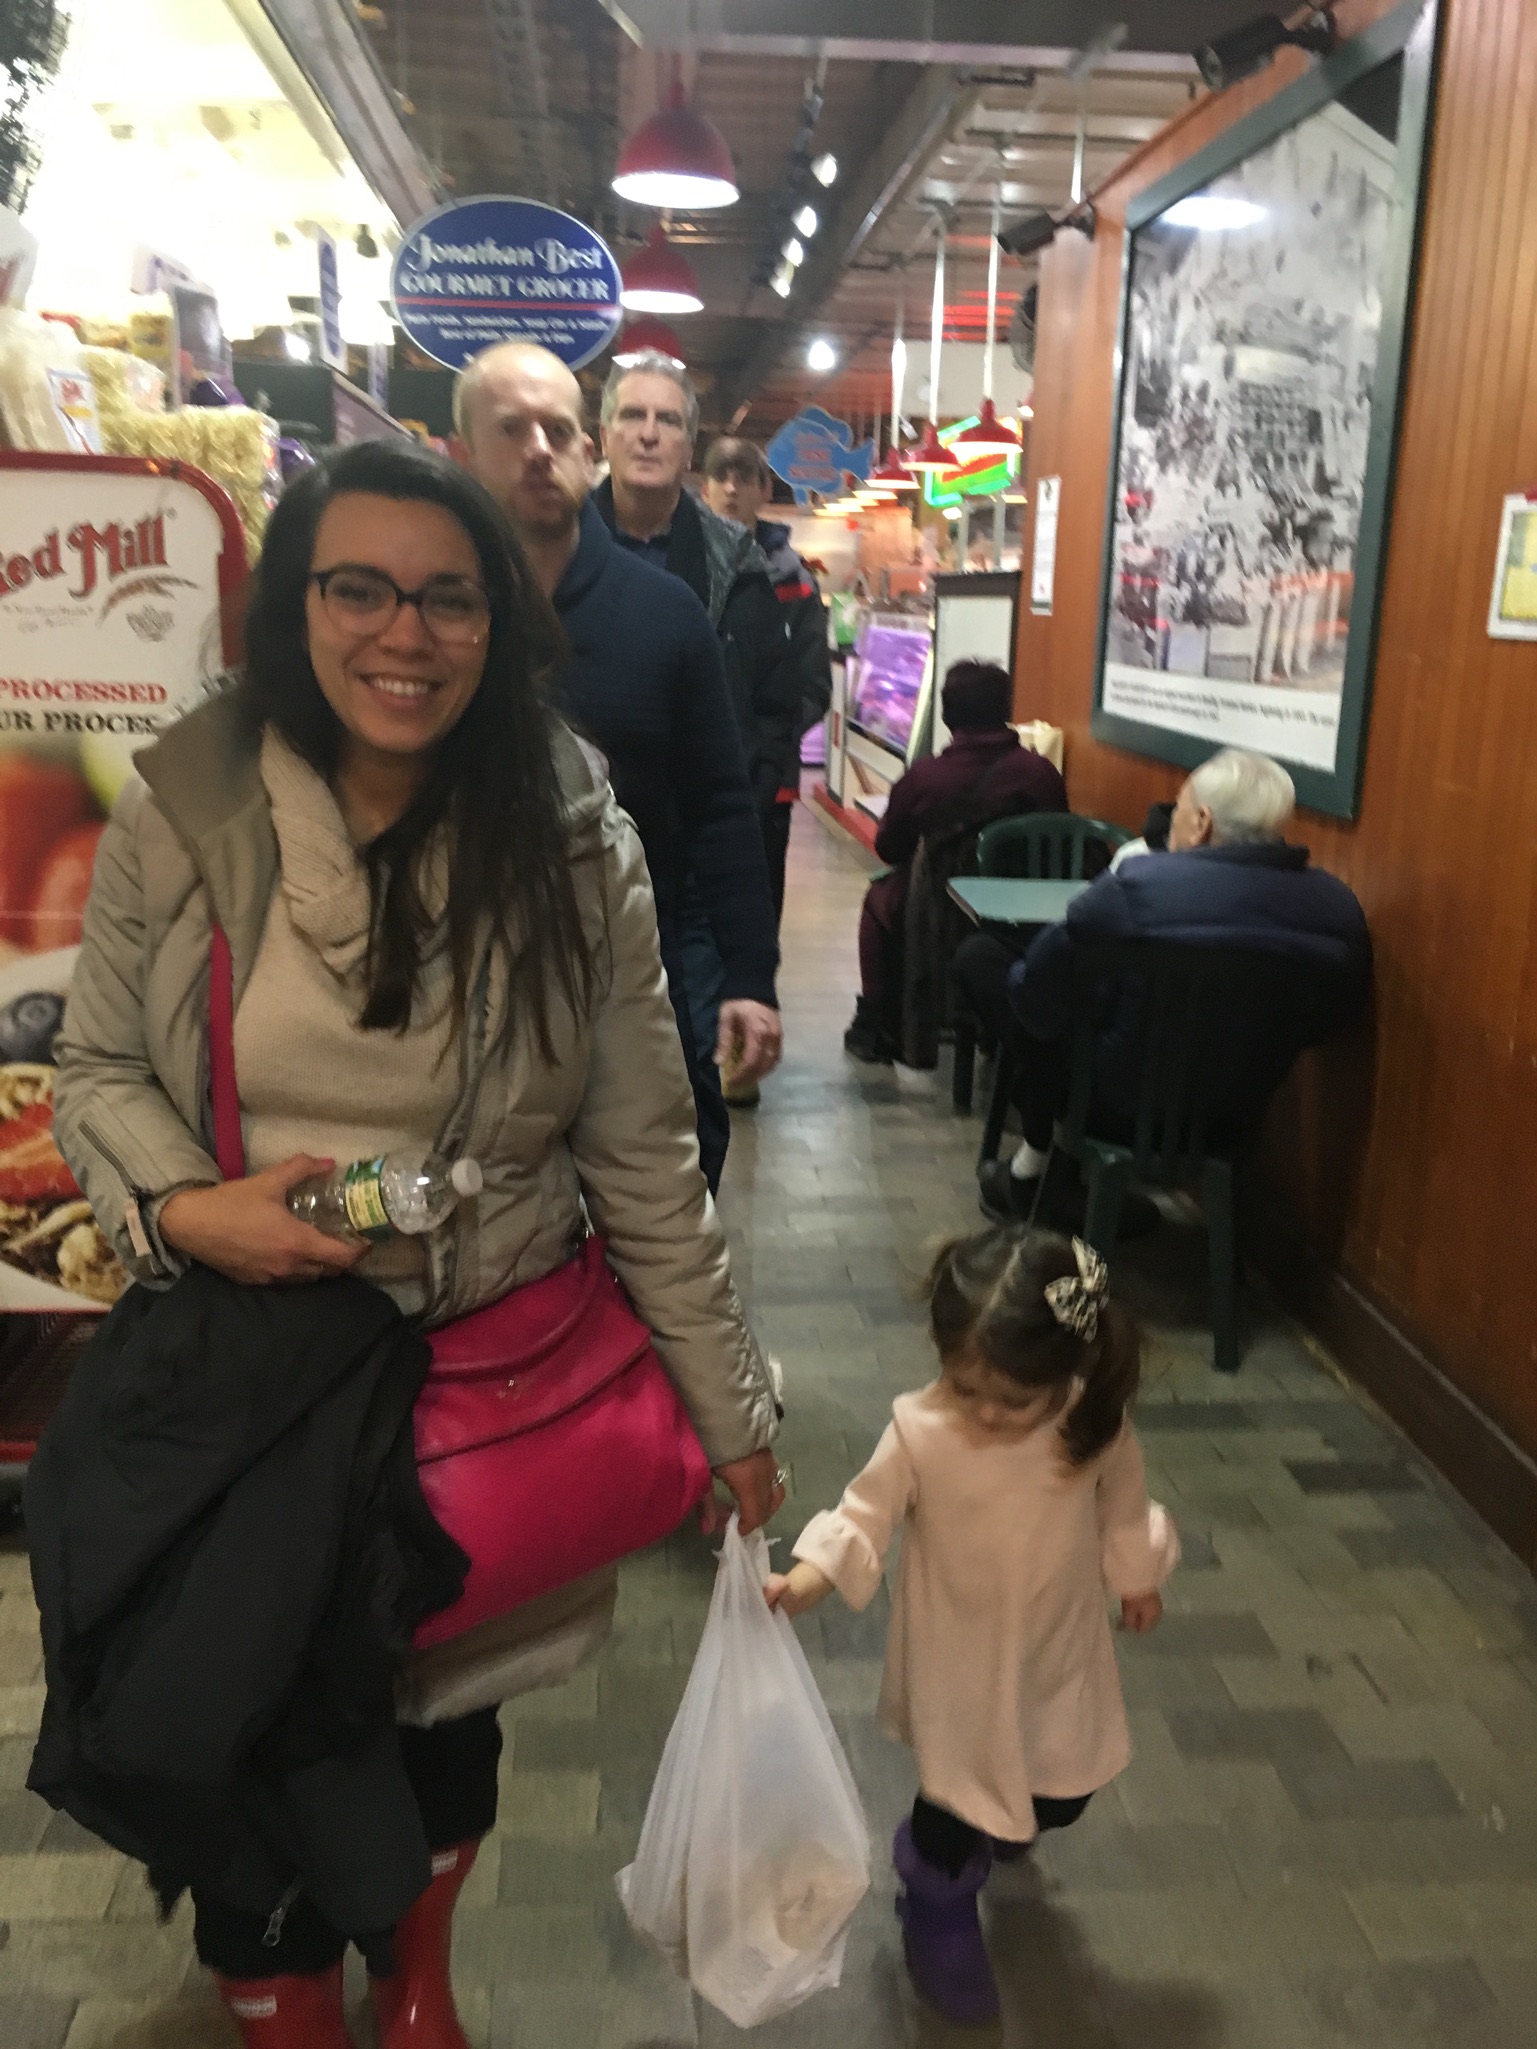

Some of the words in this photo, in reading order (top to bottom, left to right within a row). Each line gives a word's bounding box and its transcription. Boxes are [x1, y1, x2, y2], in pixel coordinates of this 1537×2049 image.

[404, 232, 536, 273] Jonathan
[533, 237, 605, 275] Best
[400, 270, 513, 298] GOURMET
[516, 274, 610, 301] GROCER
[66, 507, 170, 600] Mill
